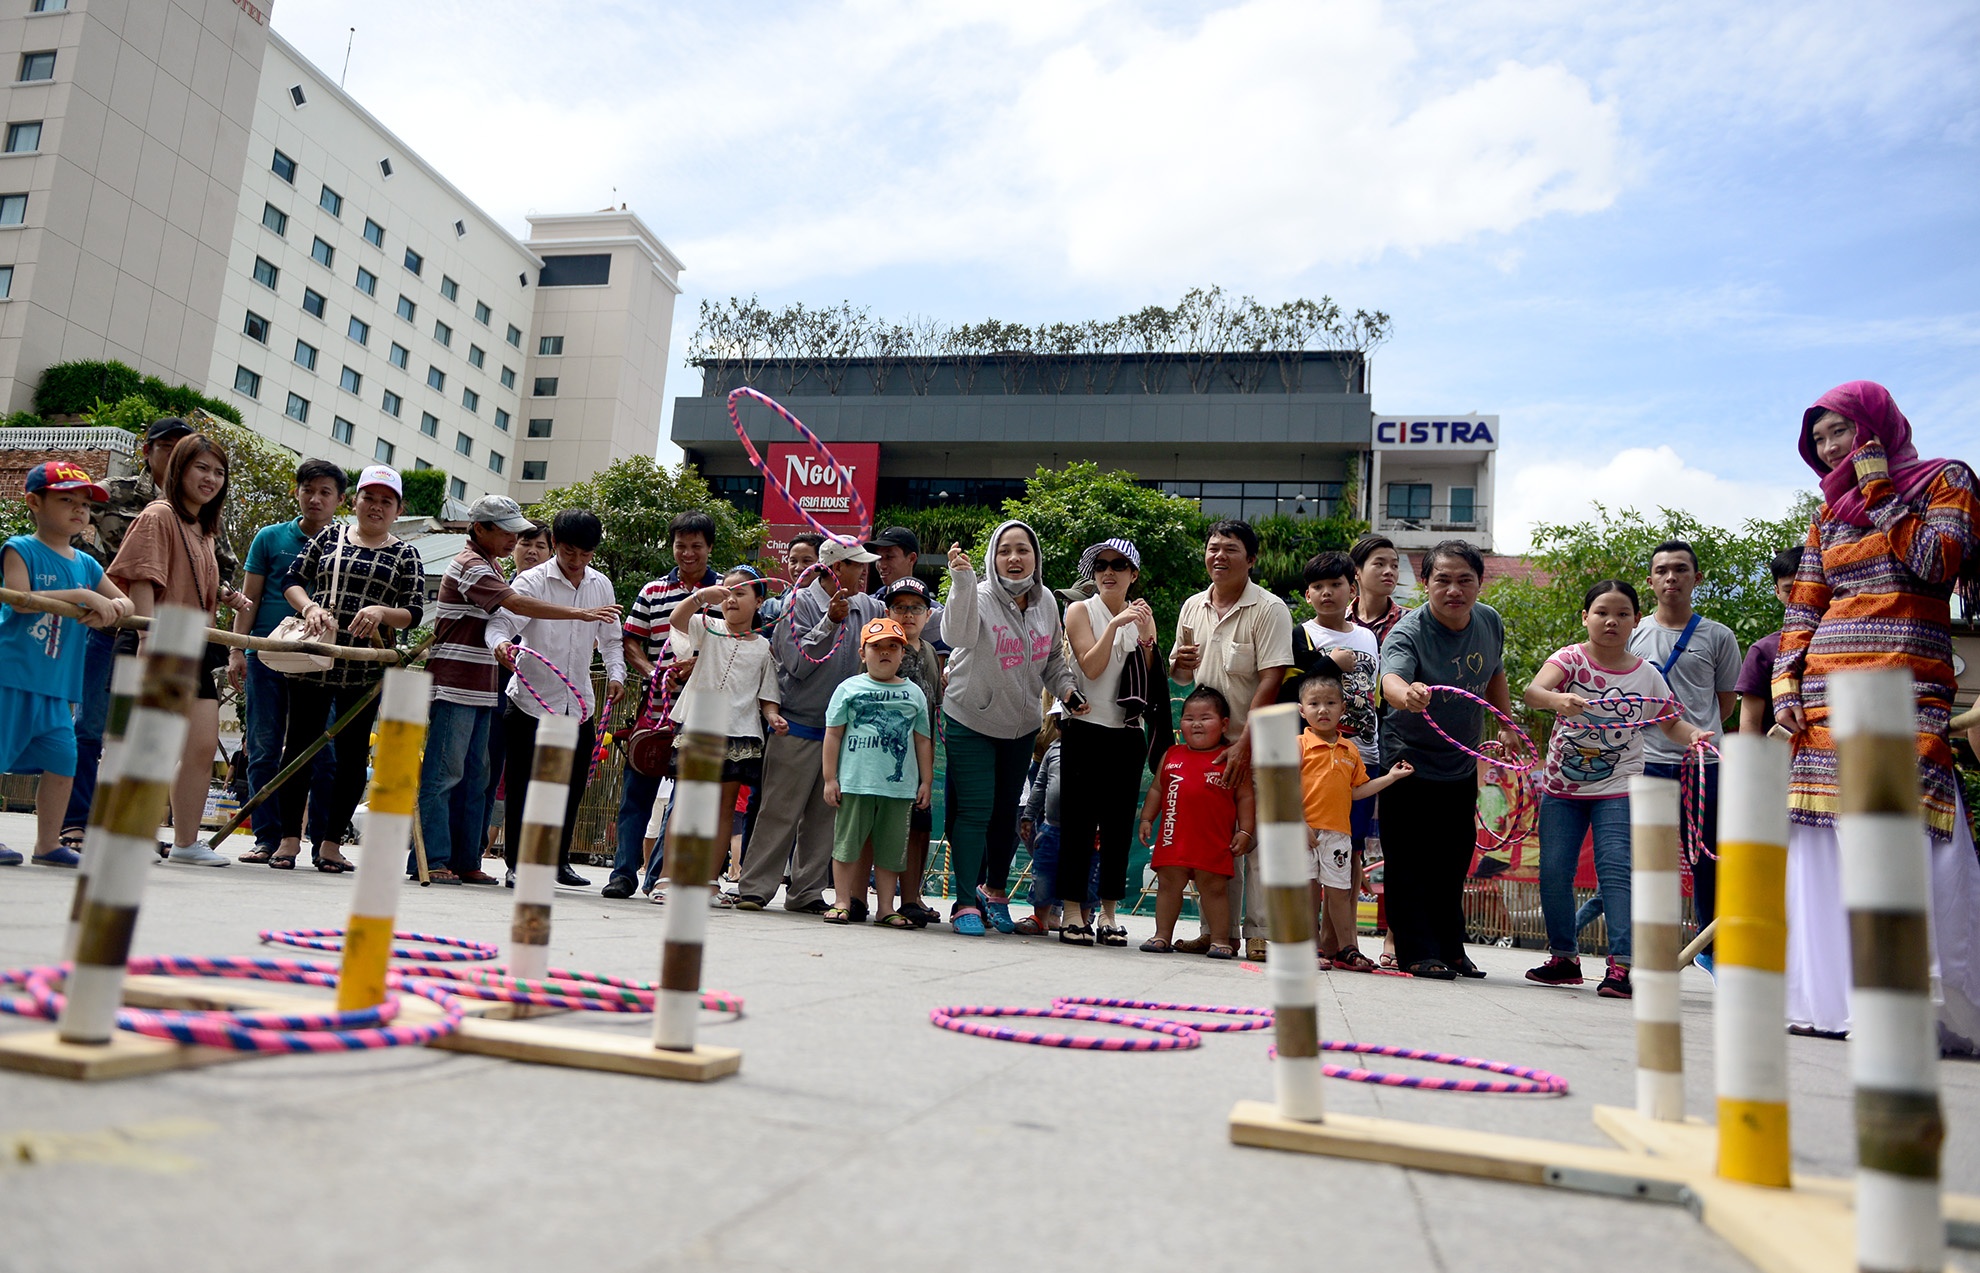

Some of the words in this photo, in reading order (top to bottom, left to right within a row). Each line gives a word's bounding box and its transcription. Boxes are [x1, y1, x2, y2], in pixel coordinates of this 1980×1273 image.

[1377, 421, 1494, 443] CISTRA
[799, 496, 819, 508] ASIA
[821, 497, 850, 508] HOUSE
[892, 580, 905, 591] ZOO
[905, 579, 925, 592] YORK
[1451, 656, 1463, 680] I
[870, 690, 910, 701] WILD
[848, 735, 890, 751] THING
[1162, 773, 1184, 847] ADEPTMEDIA
